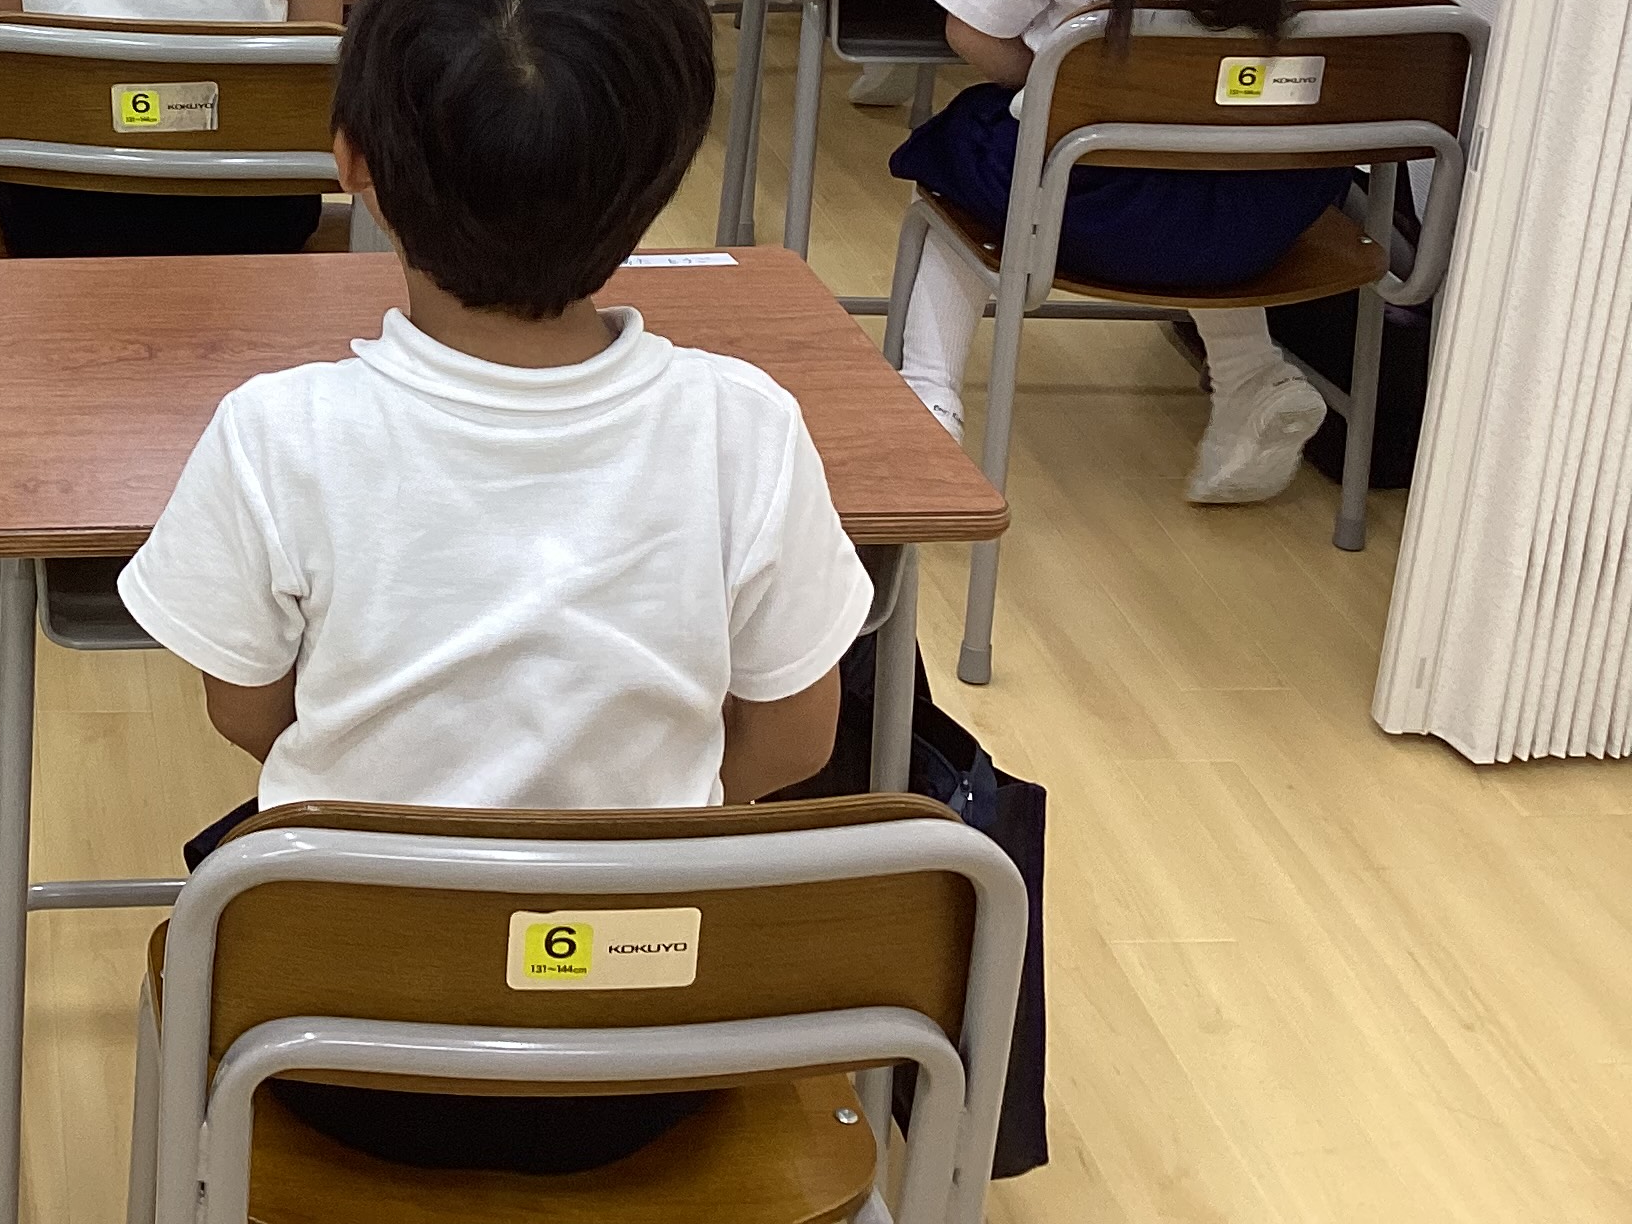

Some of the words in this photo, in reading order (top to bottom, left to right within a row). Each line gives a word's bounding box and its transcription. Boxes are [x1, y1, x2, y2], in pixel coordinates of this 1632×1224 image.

[1238, 66, 1257, 86] 6
[132, 93, 150, 113] 6
[544, 926, 577, 959] 6
[608, 942, 688, 954] KOKUYO
